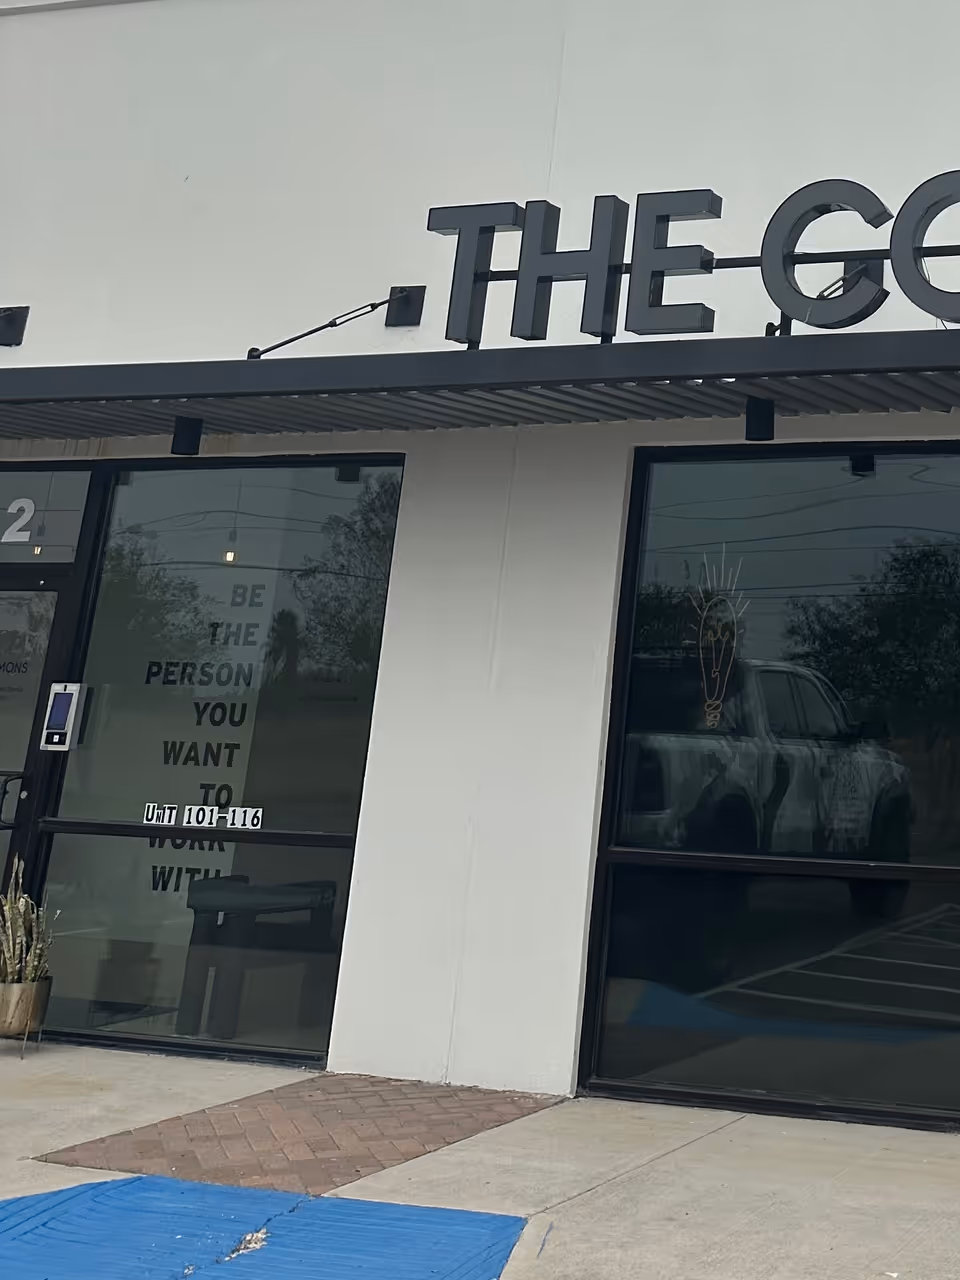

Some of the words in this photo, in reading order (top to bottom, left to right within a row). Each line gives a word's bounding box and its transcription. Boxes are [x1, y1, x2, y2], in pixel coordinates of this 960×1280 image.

[427, 188, 723, 342] THE
[1, 497, 35, 542] 2
[230, 583, 266, 608] BE
[208, 621, 260, 647] THE
[144, 660, 254, 688] PERSON
[192, 701, 248, 727] YOU
[162, 740, 241, 768] WANT
[199, 782, 234, 809] TO
[185, 806, 261, 828] 101-116
